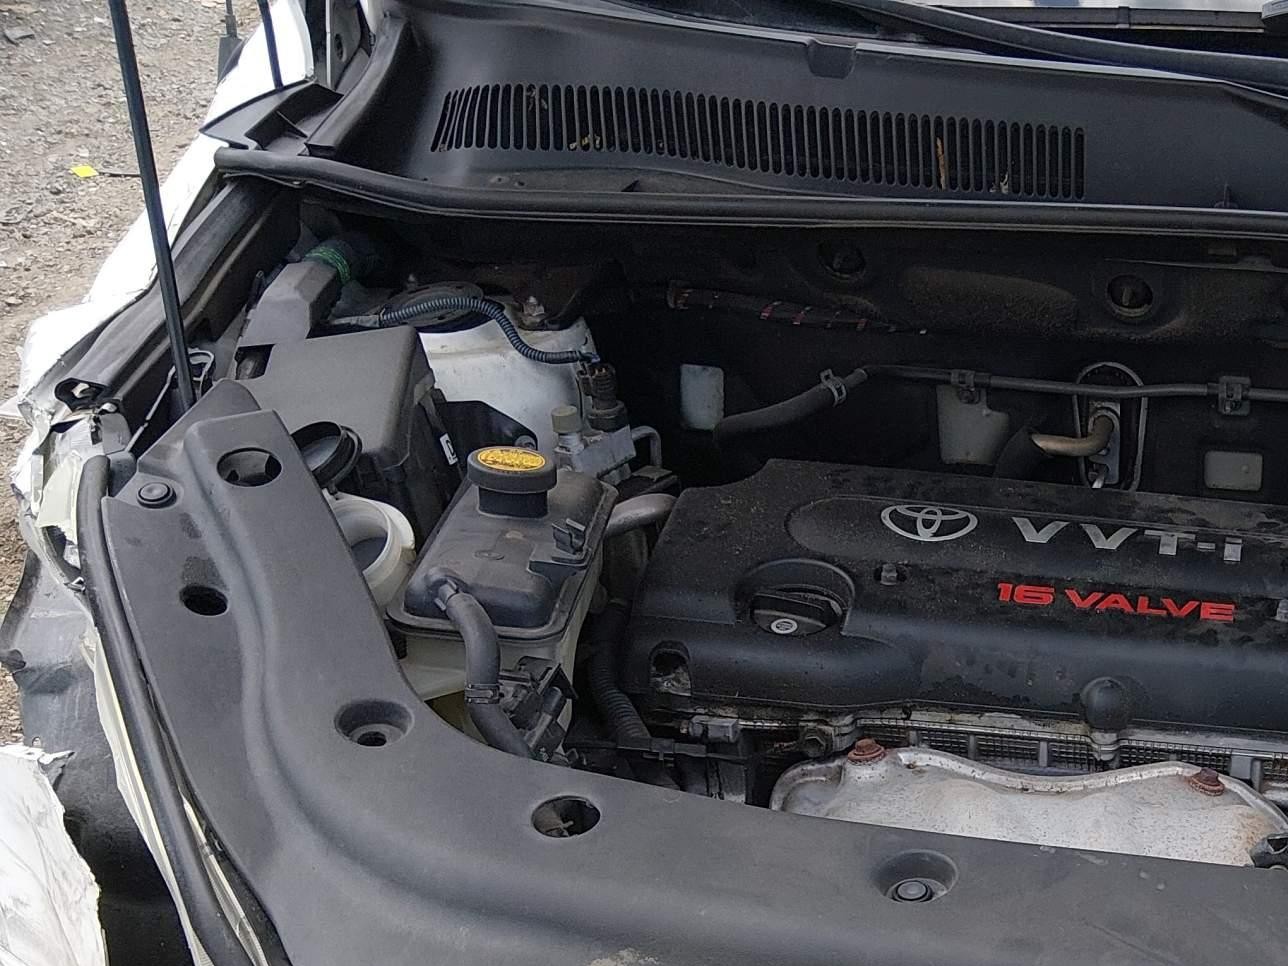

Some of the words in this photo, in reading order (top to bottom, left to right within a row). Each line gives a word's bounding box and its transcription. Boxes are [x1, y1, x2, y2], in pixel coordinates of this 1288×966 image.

[1010, 515, 1243, 562] VVT-i
[997, 582, 1055, 606] 16
[1064, 588, 1237, 623] VALVE
